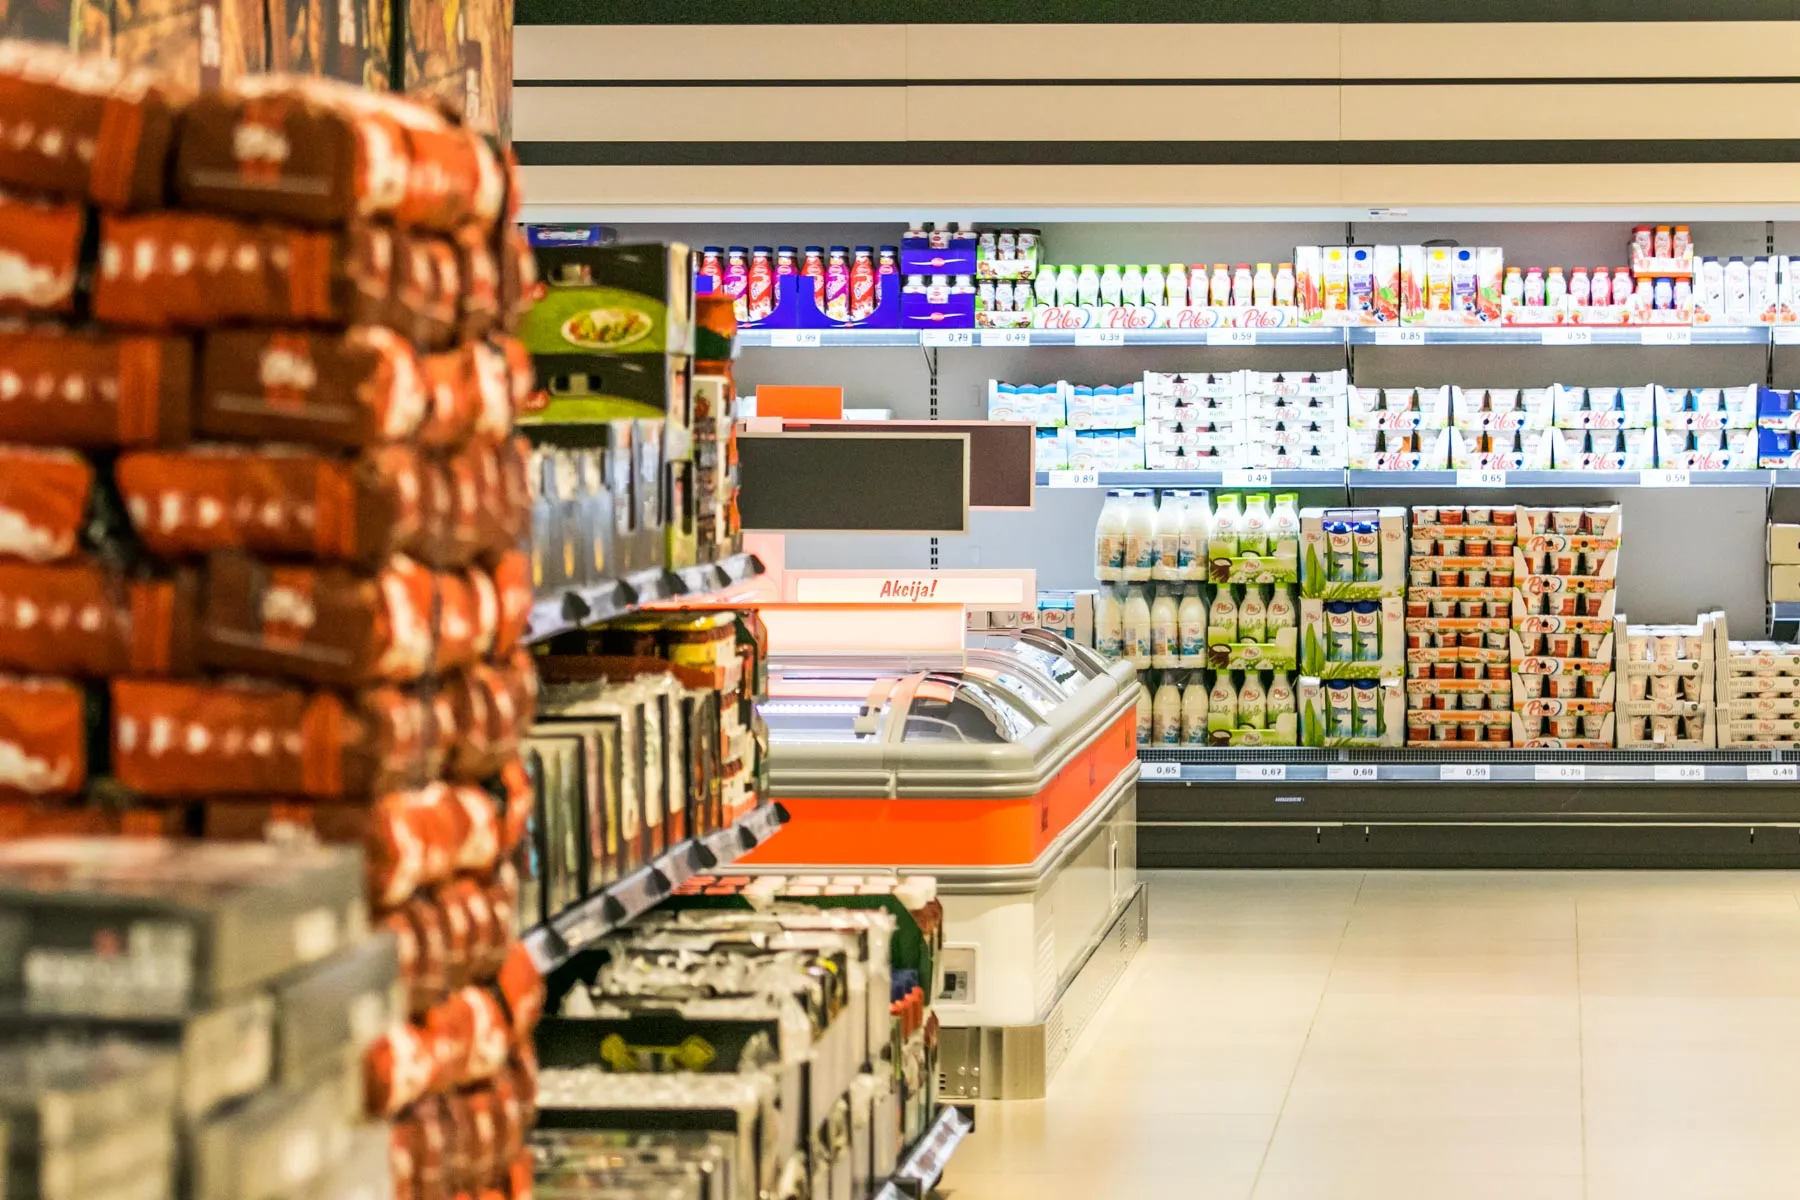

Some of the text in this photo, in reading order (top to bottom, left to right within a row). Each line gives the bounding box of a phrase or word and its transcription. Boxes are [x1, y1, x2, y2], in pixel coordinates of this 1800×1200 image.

[1042, 307, 1082, 328] Pilos
[1108, 307, 1148, 328] Pilos
[1177, 309, 1212, 328] Pilos
[1243, 308, 1277, 328] Pilos
[1376, 412, 1412, 428] Pilos
[1480, 412, 1516, 428] Pilos
[1580, 412, 1615, 428] Pilos
[1684, 412, 1719, 428] Pilos
[1375, 452, 1411, 469] Pilos
[1478, 452, 1514, 469] Pilos
[1580, 452, 1615, 469] Pilos
[1685, 452, 1721, 469] Pilos
[880, 580, 938, 603] Akcija!
